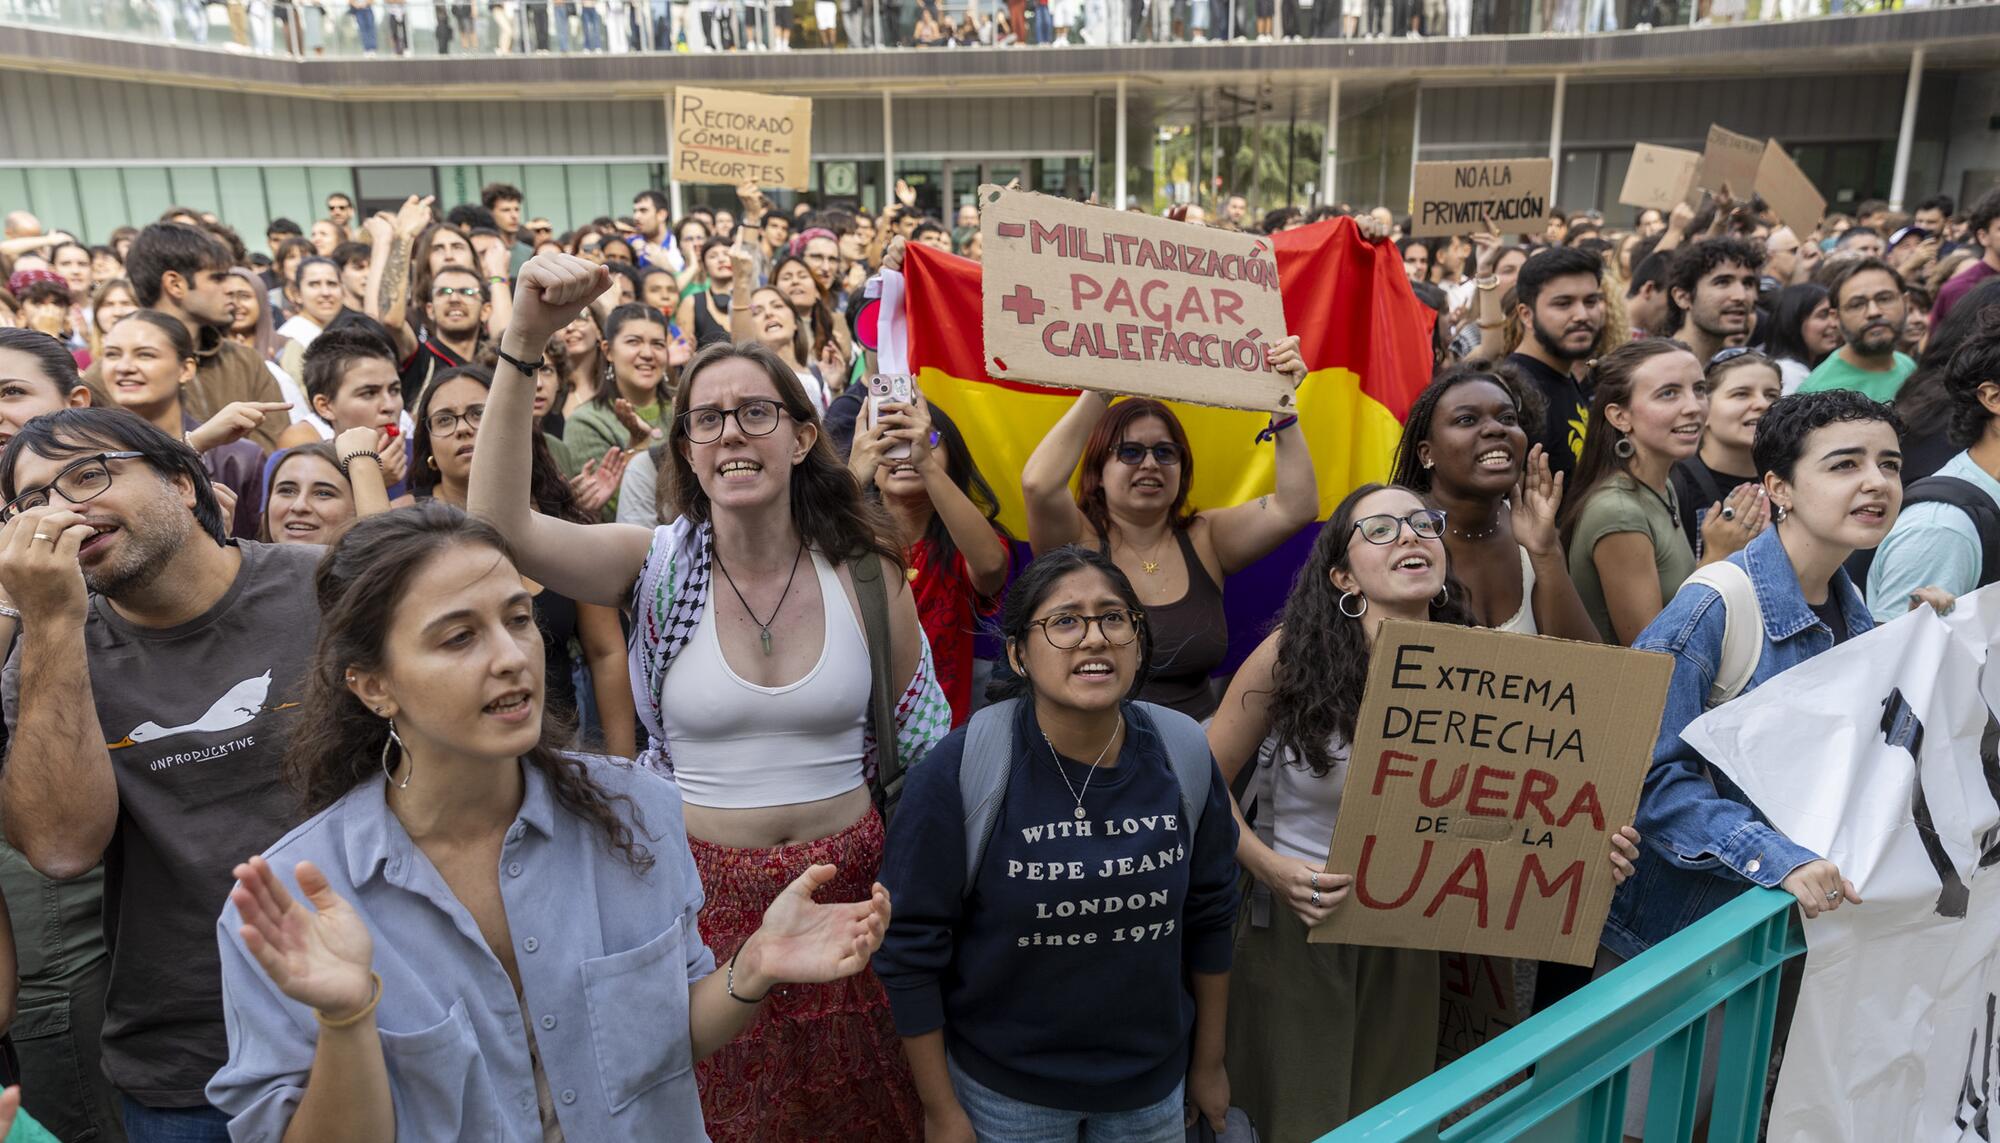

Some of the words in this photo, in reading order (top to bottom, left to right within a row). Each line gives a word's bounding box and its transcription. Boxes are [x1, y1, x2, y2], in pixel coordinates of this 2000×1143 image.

[682, 95, 793, 135] RECTORADO
[680, 151, 785, 183] RECORTES
[1455, 167, 1477, 188] NO
[1478, 166, 1490, 187] A
[1493, 165, 1512, 186] LA
[1422, 190, 1544, 225] PRIVATIZACIÓN
[1069, 273, 1245, 330] PAGAR
[1391, 644, 1576, 715] EXTREMA
[1382, 705, 1585, 763] DERECHA
[150, 736, 256, 772] UNPRODUCKTIVE
[1371, 750, 1606, 831] FUERA
[1021, 820, 1093, 844] WITH
[1104, 814, 1178, 836] LOVE
[1415, 815, 1449, 834] DE
[1521, 828, 1554, 848] LA
[1007, 859, 1085, 881] PEPE
[1098, 843, 1184, 878] JEANS
[1355, 834, 1586, 935] UAM
[1036, 889, 1169, 919] LONDON
[1018, 932, 1098, 947] since
[1111, 919, 1175, 943] 1973
